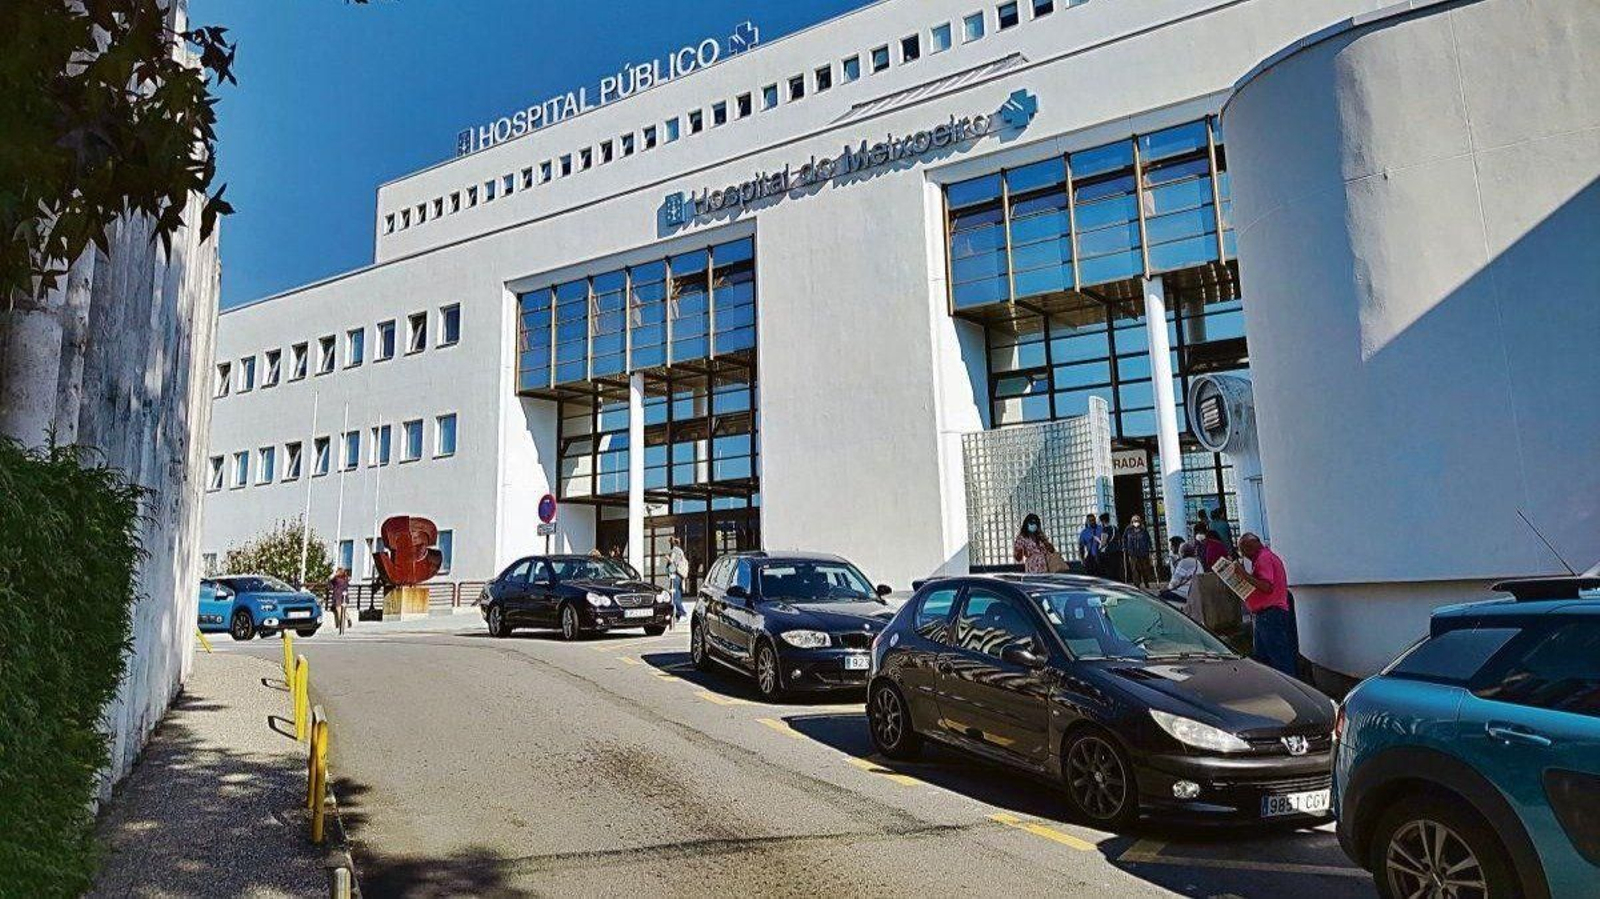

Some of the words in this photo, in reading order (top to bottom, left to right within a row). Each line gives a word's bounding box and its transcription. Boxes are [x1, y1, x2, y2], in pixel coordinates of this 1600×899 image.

[479, 87, 594, 149] HOSPITAL
[600, 38, 719, 105] PÚBLICO
[691, 163, 789, 214] Hospital
[844, 114, 991, 171] Meixoeiro
[1270, 796, 1299, 814] 9851
[1306, 791, 1329, 809] CGV
